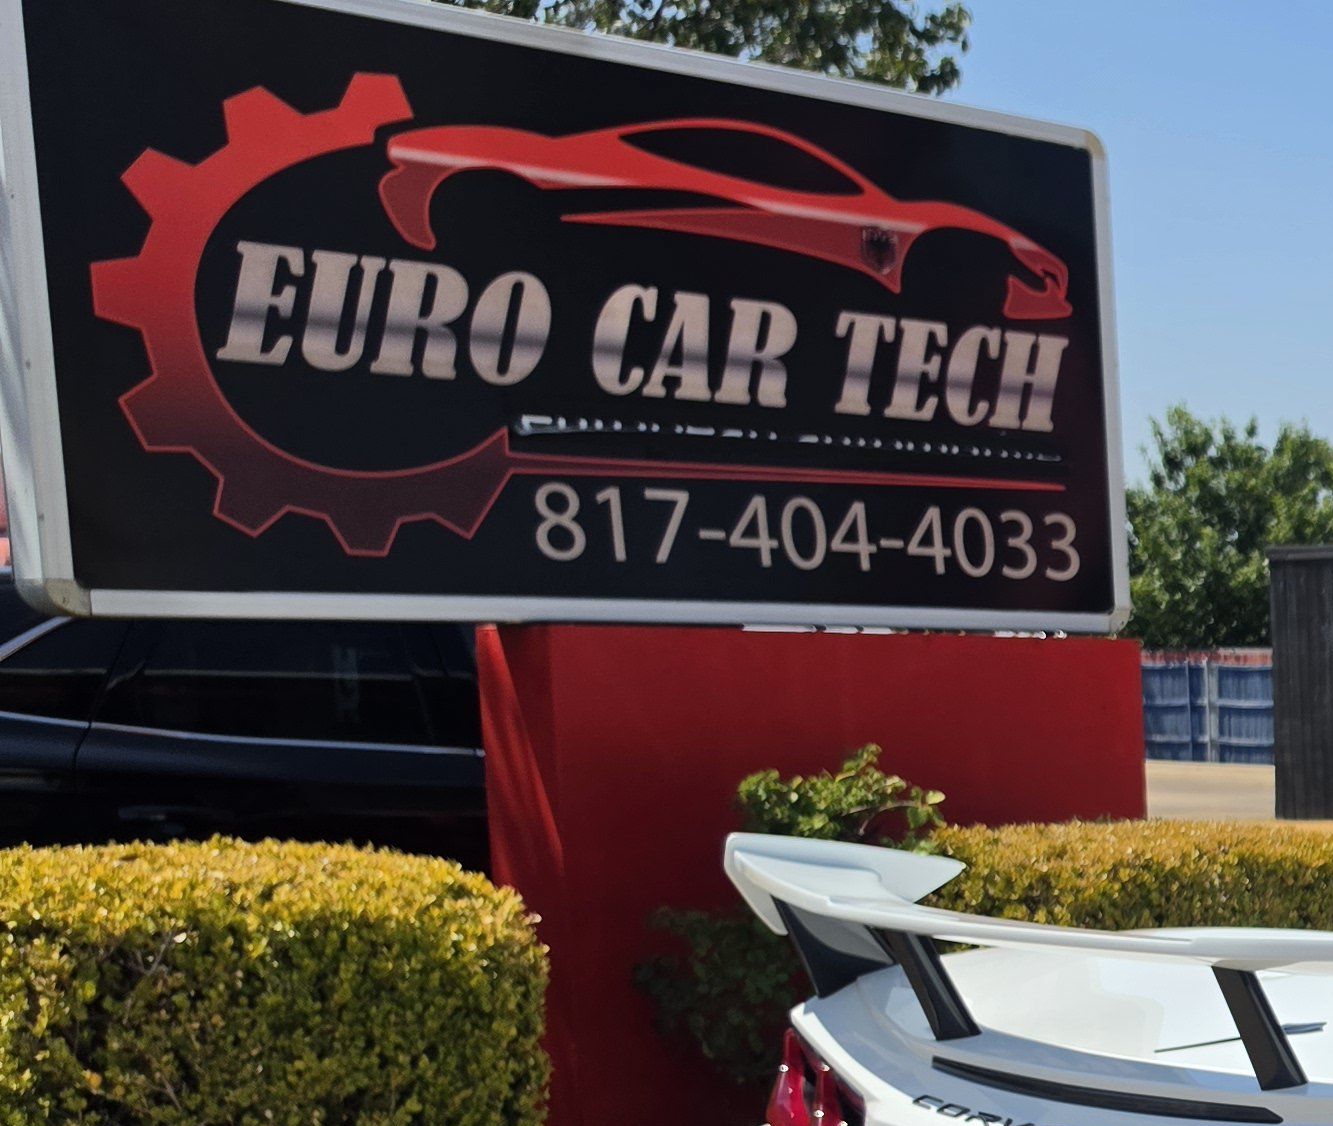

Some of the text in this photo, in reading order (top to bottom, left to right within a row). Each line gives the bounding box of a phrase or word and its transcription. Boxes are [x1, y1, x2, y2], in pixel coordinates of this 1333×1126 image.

[217, 240, 1069, 433] EURO CAR TECH
[534, 481, 1081, 582] 817-404-4033
